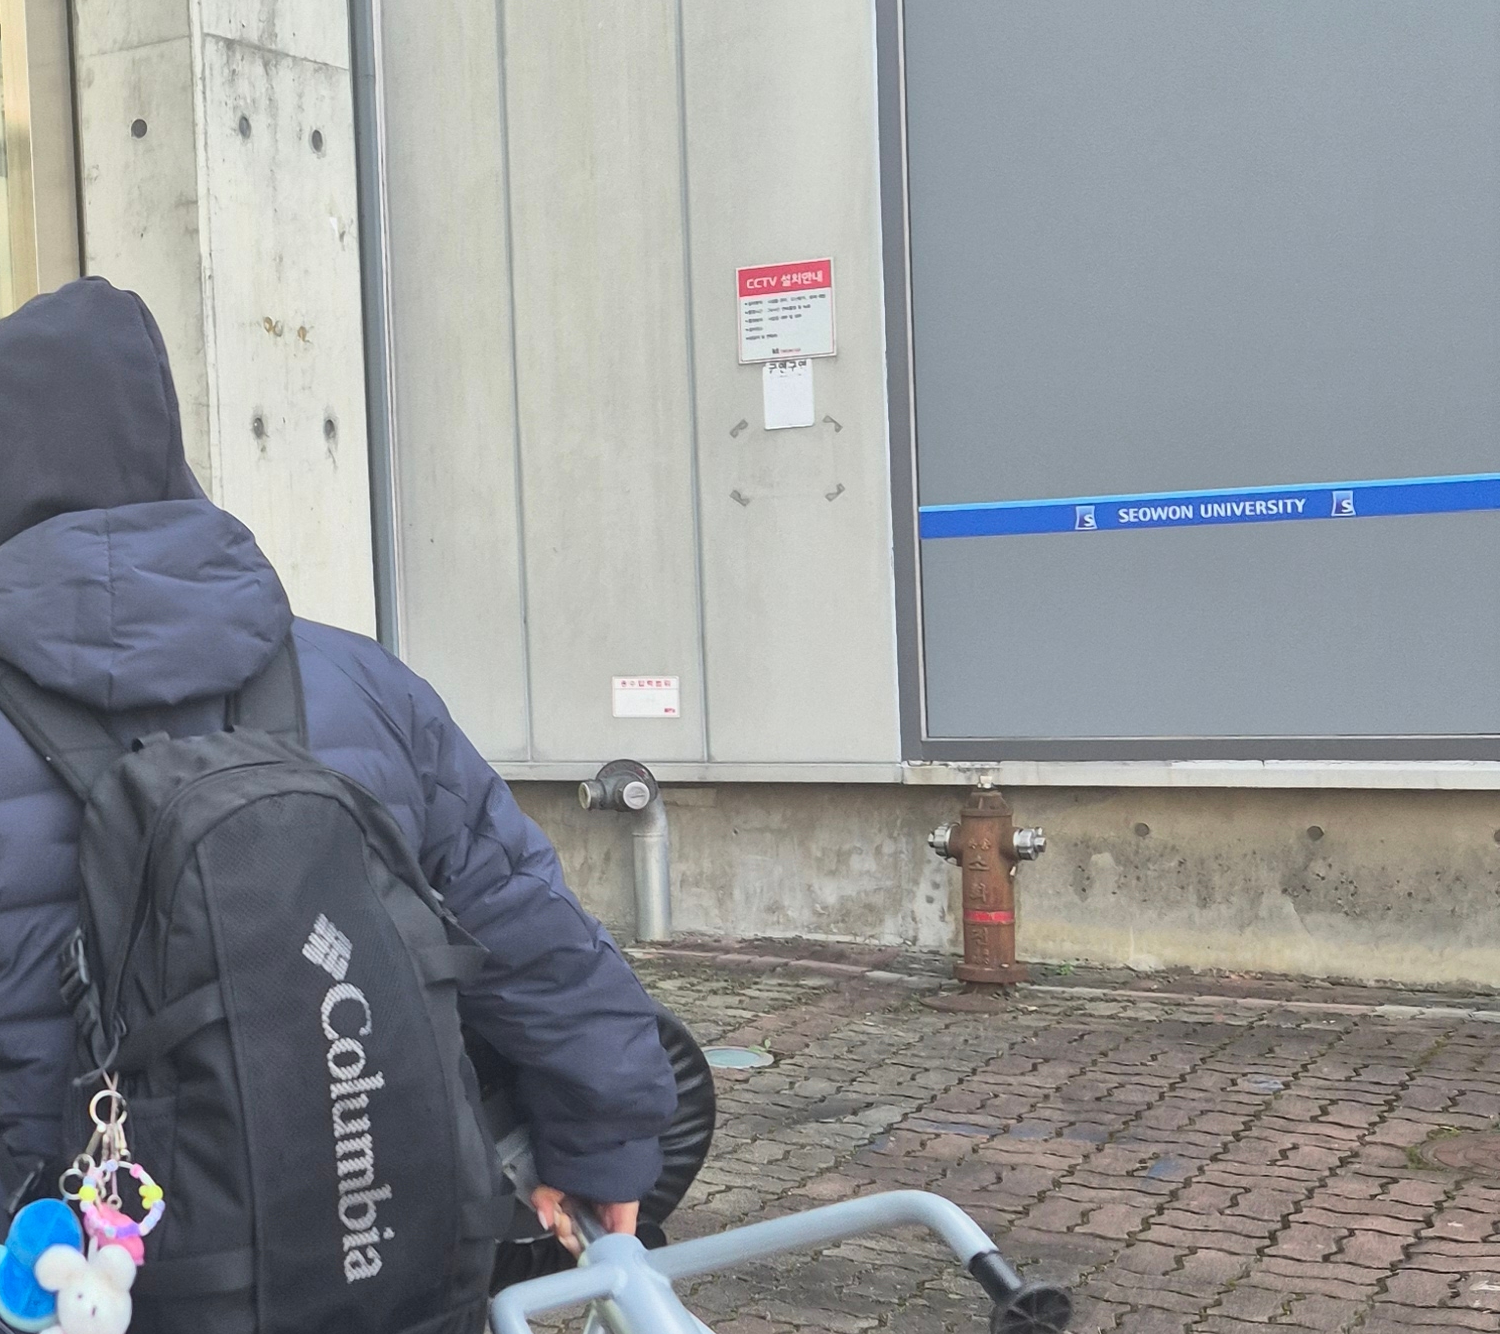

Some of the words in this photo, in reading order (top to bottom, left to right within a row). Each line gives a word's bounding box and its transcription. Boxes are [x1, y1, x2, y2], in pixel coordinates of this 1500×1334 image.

[746, 276, 778, 289] CCTV
[1117, 504, 1194, 524] SEOWON
[1199, 498, 1307, 519] UNIVERSITY
[320, 982, 396, 1285] Columbia
